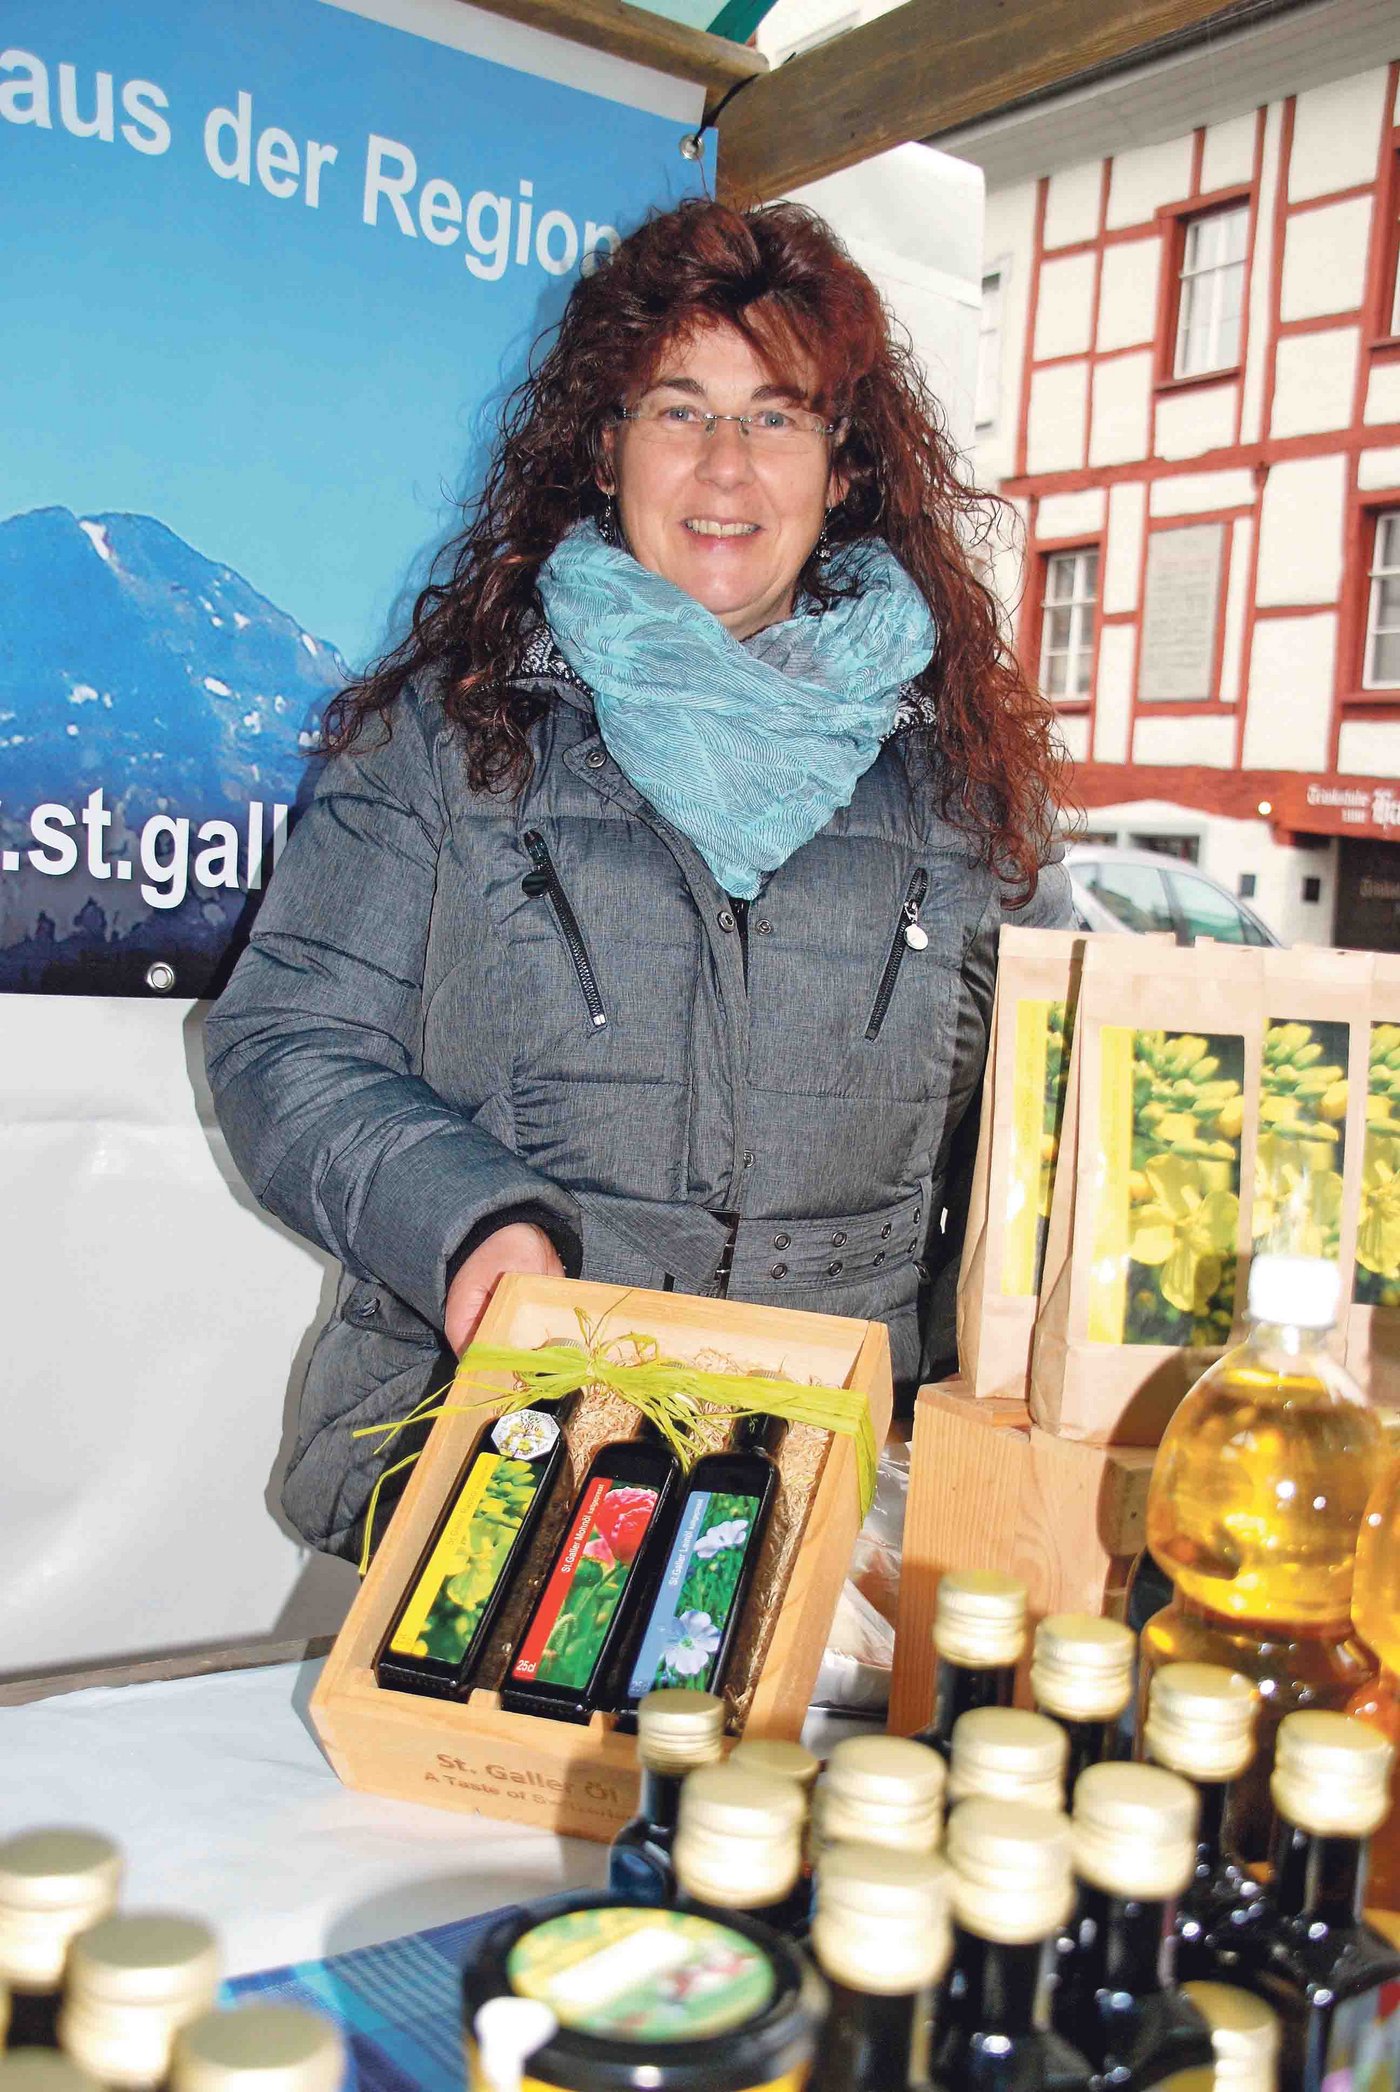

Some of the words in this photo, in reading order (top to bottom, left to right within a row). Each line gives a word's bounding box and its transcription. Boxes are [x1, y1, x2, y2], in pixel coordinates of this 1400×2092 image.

[0, 48, 172, 156] aus
[203, 90, 338, 210] der
[362, 133, 622, 281] Region
[0, 787, 289, 909] .st.gall
[561, 1541, 581, 1573] St.Galler
[574, 1515, 592, 1541] Mohnöl
[516, 1659, 537, 1672] 25cl
[424, 1771, 439, 1783] A
[442, 1774, 501, 1796] Taste
[506, 1790, 525, 1801] of
[436, 1753, 476, 1775] St.
[485, 1763, 576, 1794] Galler
[584, 1780, 618, 1803] Öl
